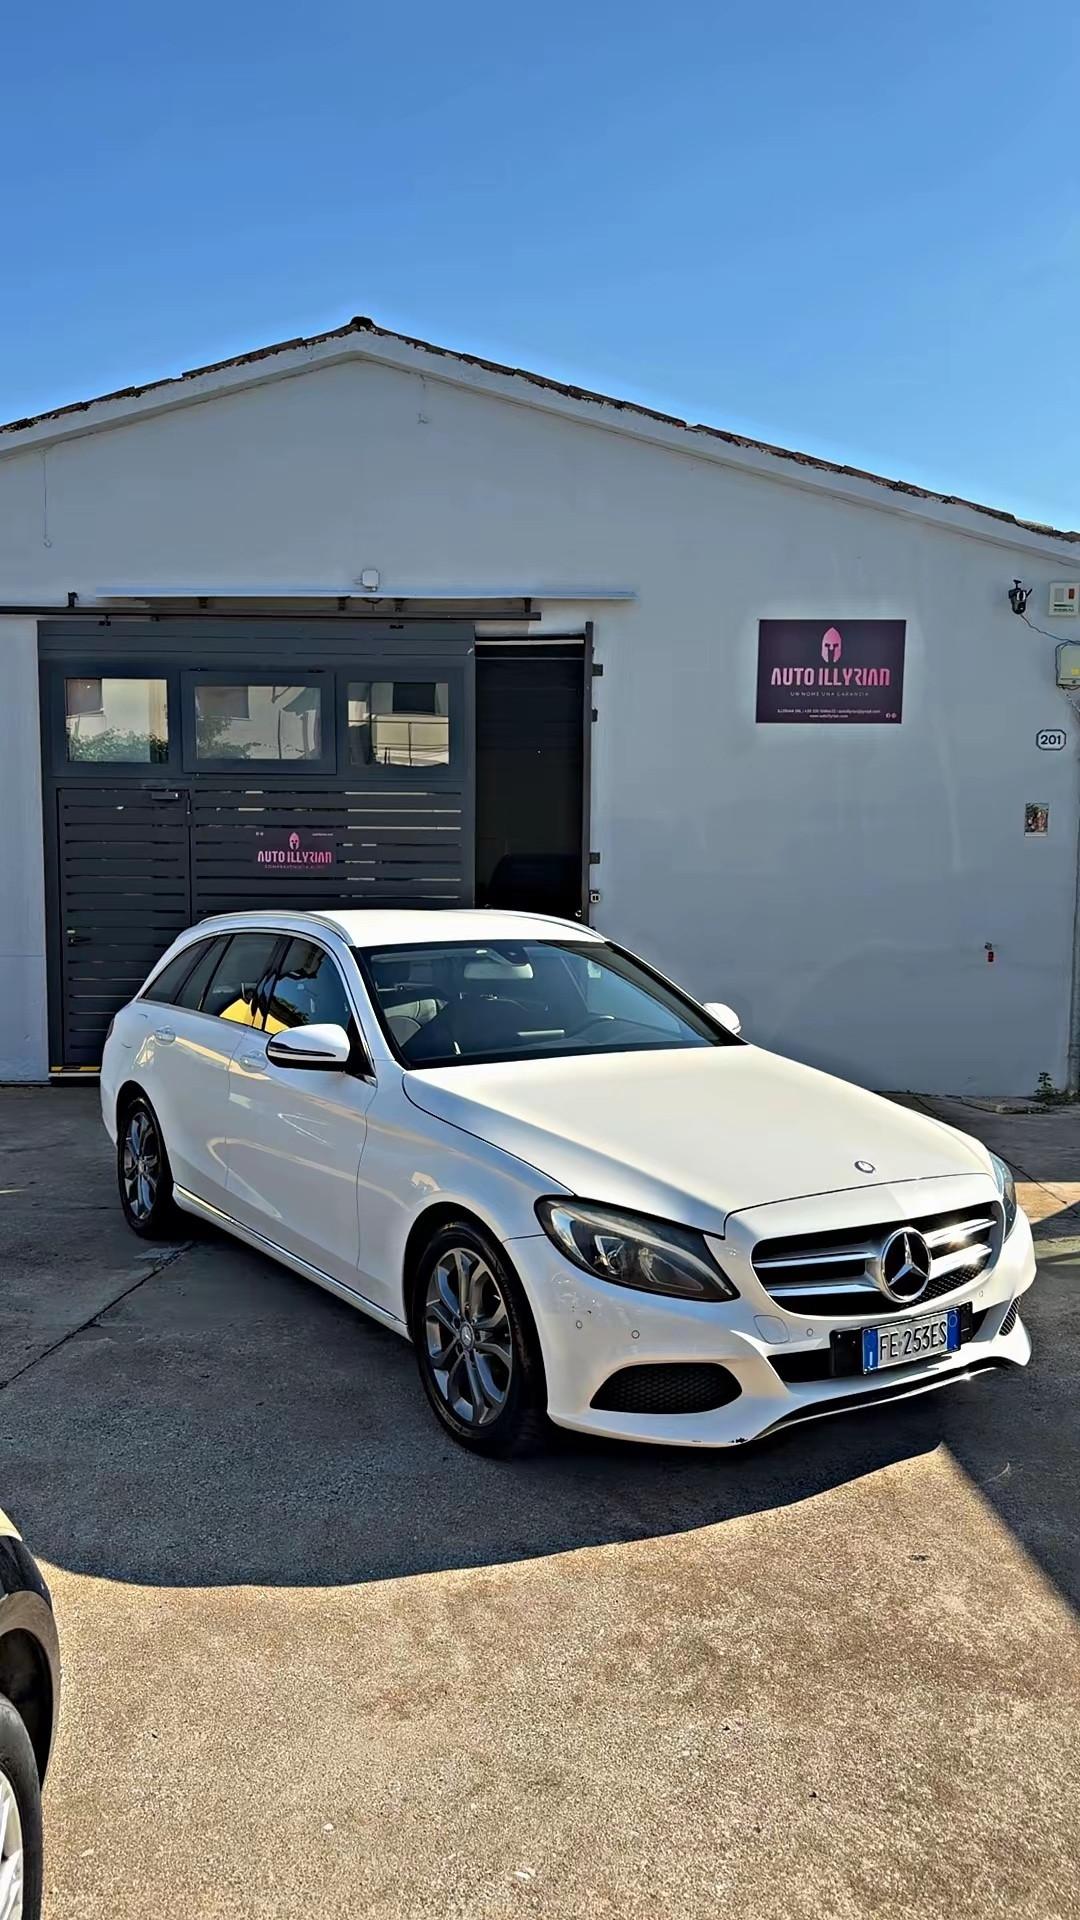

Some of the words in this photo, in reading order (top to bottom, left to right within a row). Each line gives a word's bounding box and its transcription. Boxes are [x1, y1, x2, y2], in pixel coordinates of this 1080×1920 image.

[770, 667, 815, 686] AUTO
[818, 667, 890, 686] ILLYRIAN
[1040, 734, 1061, 745] 201
[257, 850, 285, 863] AUTO
[287, 851, 332, 863] ILLYRIAN
